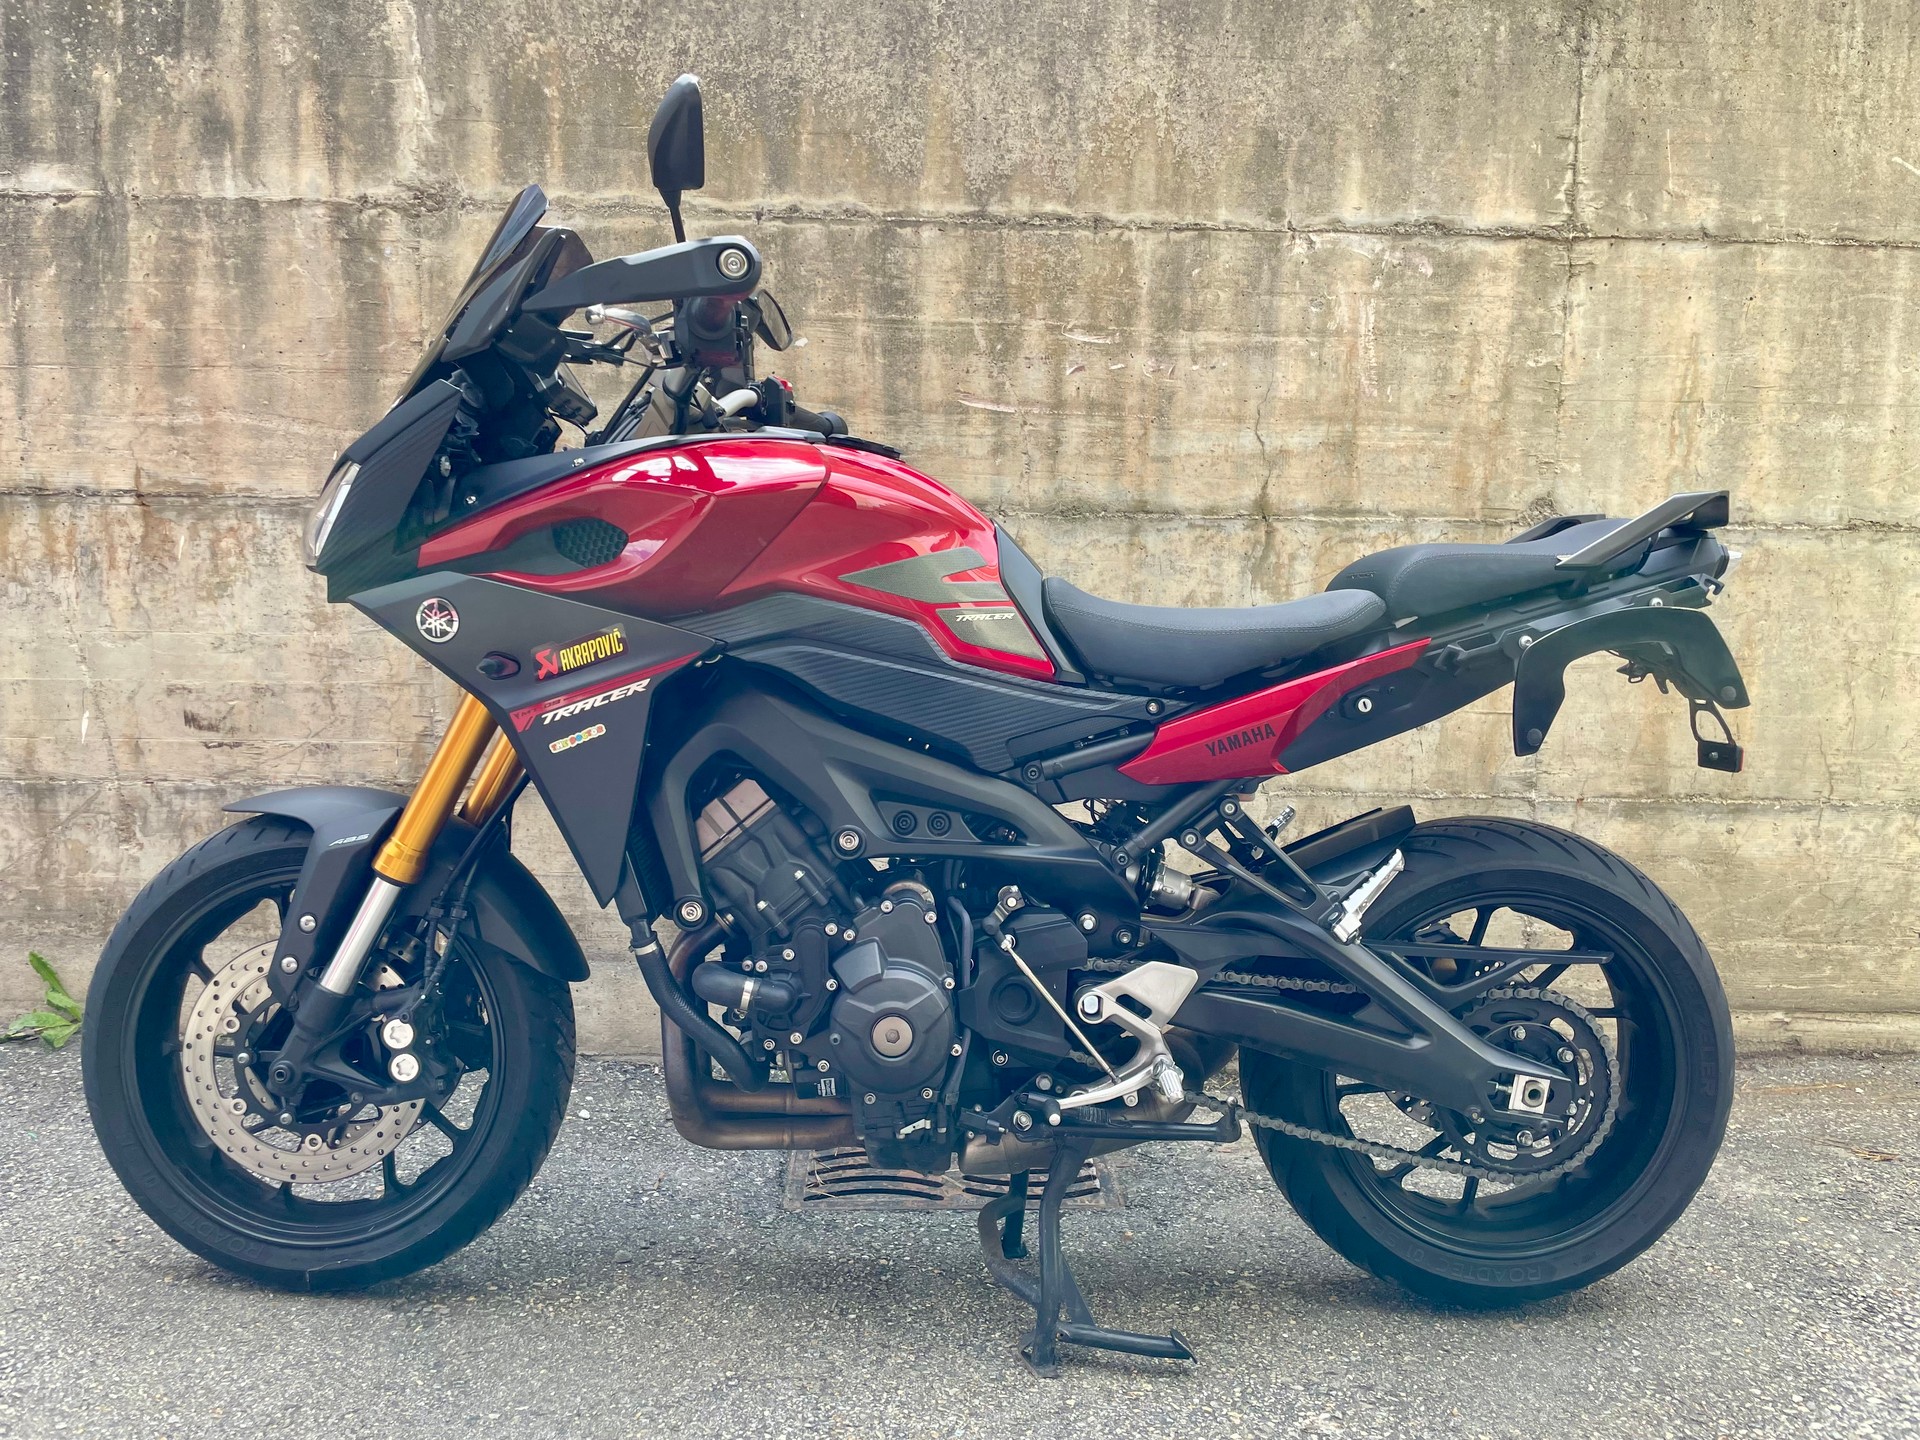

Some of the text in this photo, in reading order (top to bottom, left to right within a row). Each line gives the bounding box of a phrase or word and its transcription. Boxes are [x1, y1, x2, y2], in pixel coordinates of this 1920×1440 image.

[955, 612, 1016, 622] TRACER
[541, 678, 651, 725] TRACER
[1205, 723, 1276, 757] YAMAHA
[328, 833, 370, 847] ABS
[1437, 1257, 1542, 1283] ROADTEC
